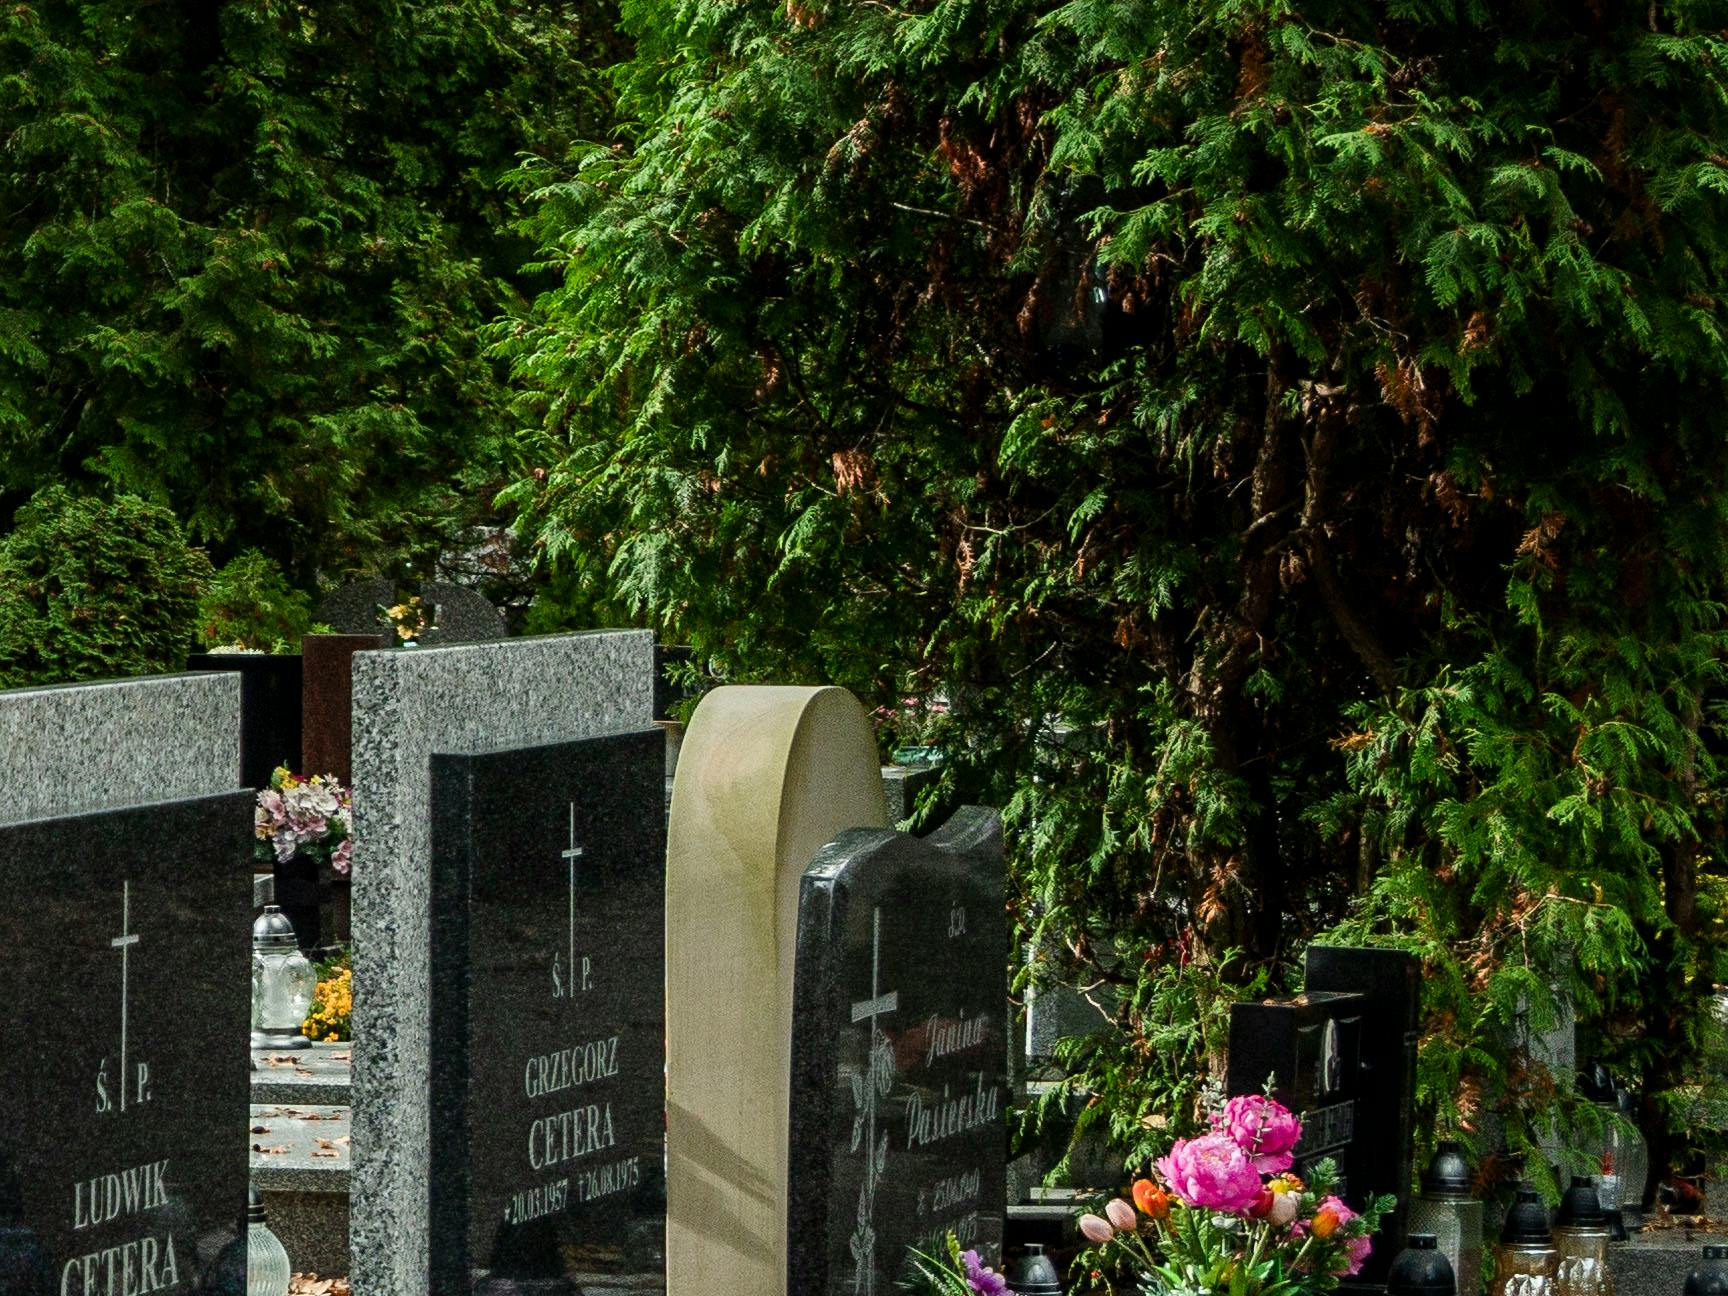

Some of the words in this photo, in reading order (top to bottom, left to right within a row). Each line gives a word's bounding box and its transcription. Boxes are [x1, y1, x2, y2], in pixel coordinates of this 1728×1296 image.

[525, 1036, 620, 1099] GRZEGORZ
[926, 1008, 990, 1068] Janina
[528, 1103, 616, 1171] CETERA
[73, 1159, 170, 1230] LUDWIK
